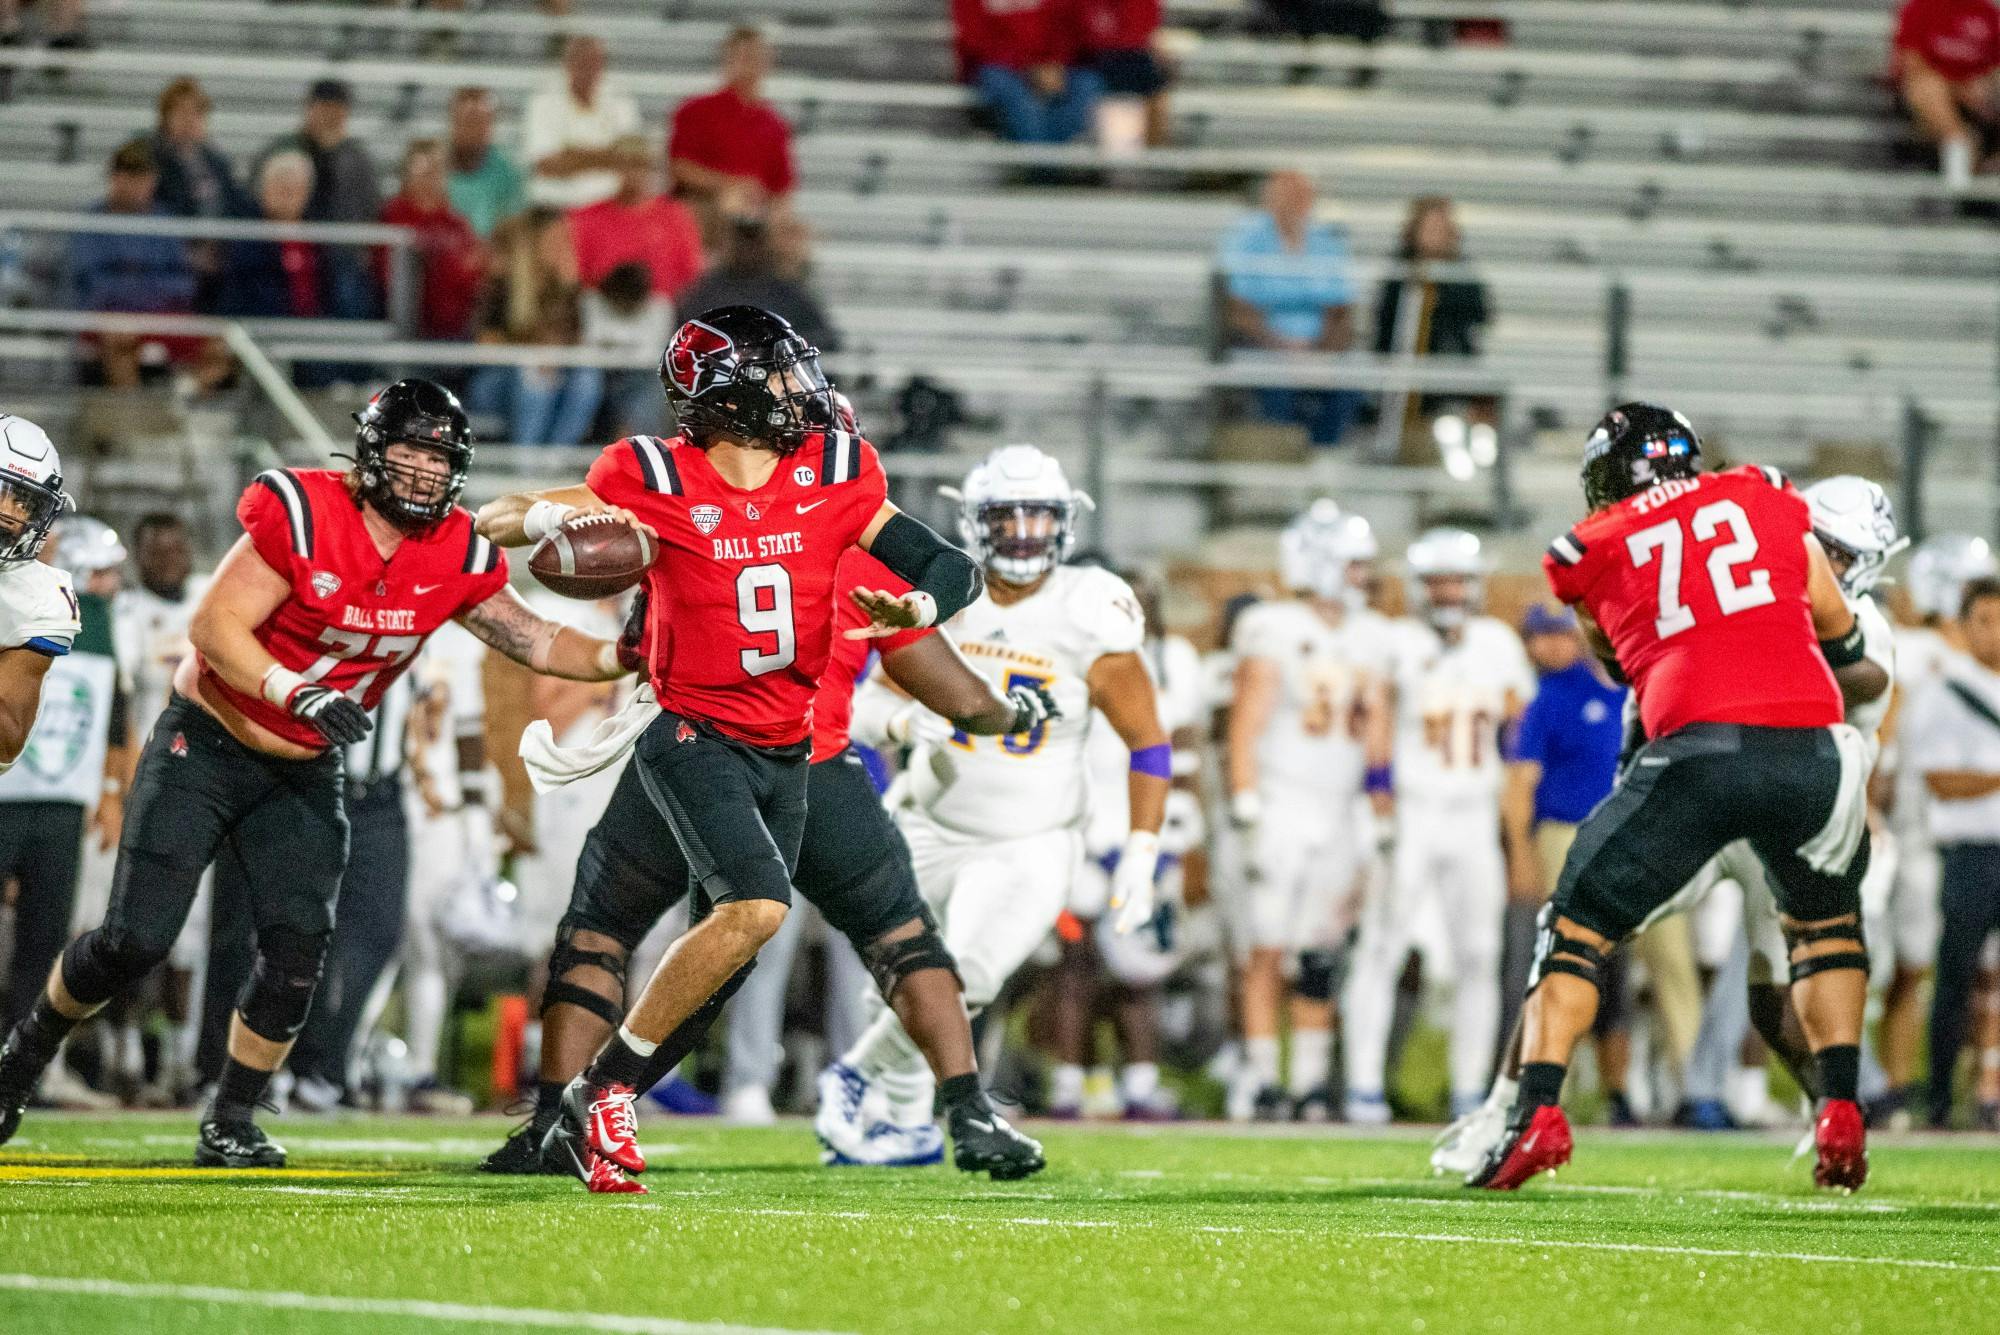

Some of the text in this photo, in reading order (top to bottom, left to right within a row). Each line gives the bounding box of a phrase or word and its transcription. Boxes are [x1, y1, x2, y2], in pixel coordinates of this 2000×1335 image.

[8, 462, 37, 479] Riddell
[796, 470, 813, 482] TC
[1631, 477, 1701, 515] TODD
[693, 514, 721, 523] MAC
[713, 532, 804, 560] BALL STATE
[1625, 498, 1777, 640] 72
[342, 604, 416, 630] BALL STATE
[735, 561, 797, 677] 9
[299, 625, 423, 706] 77
